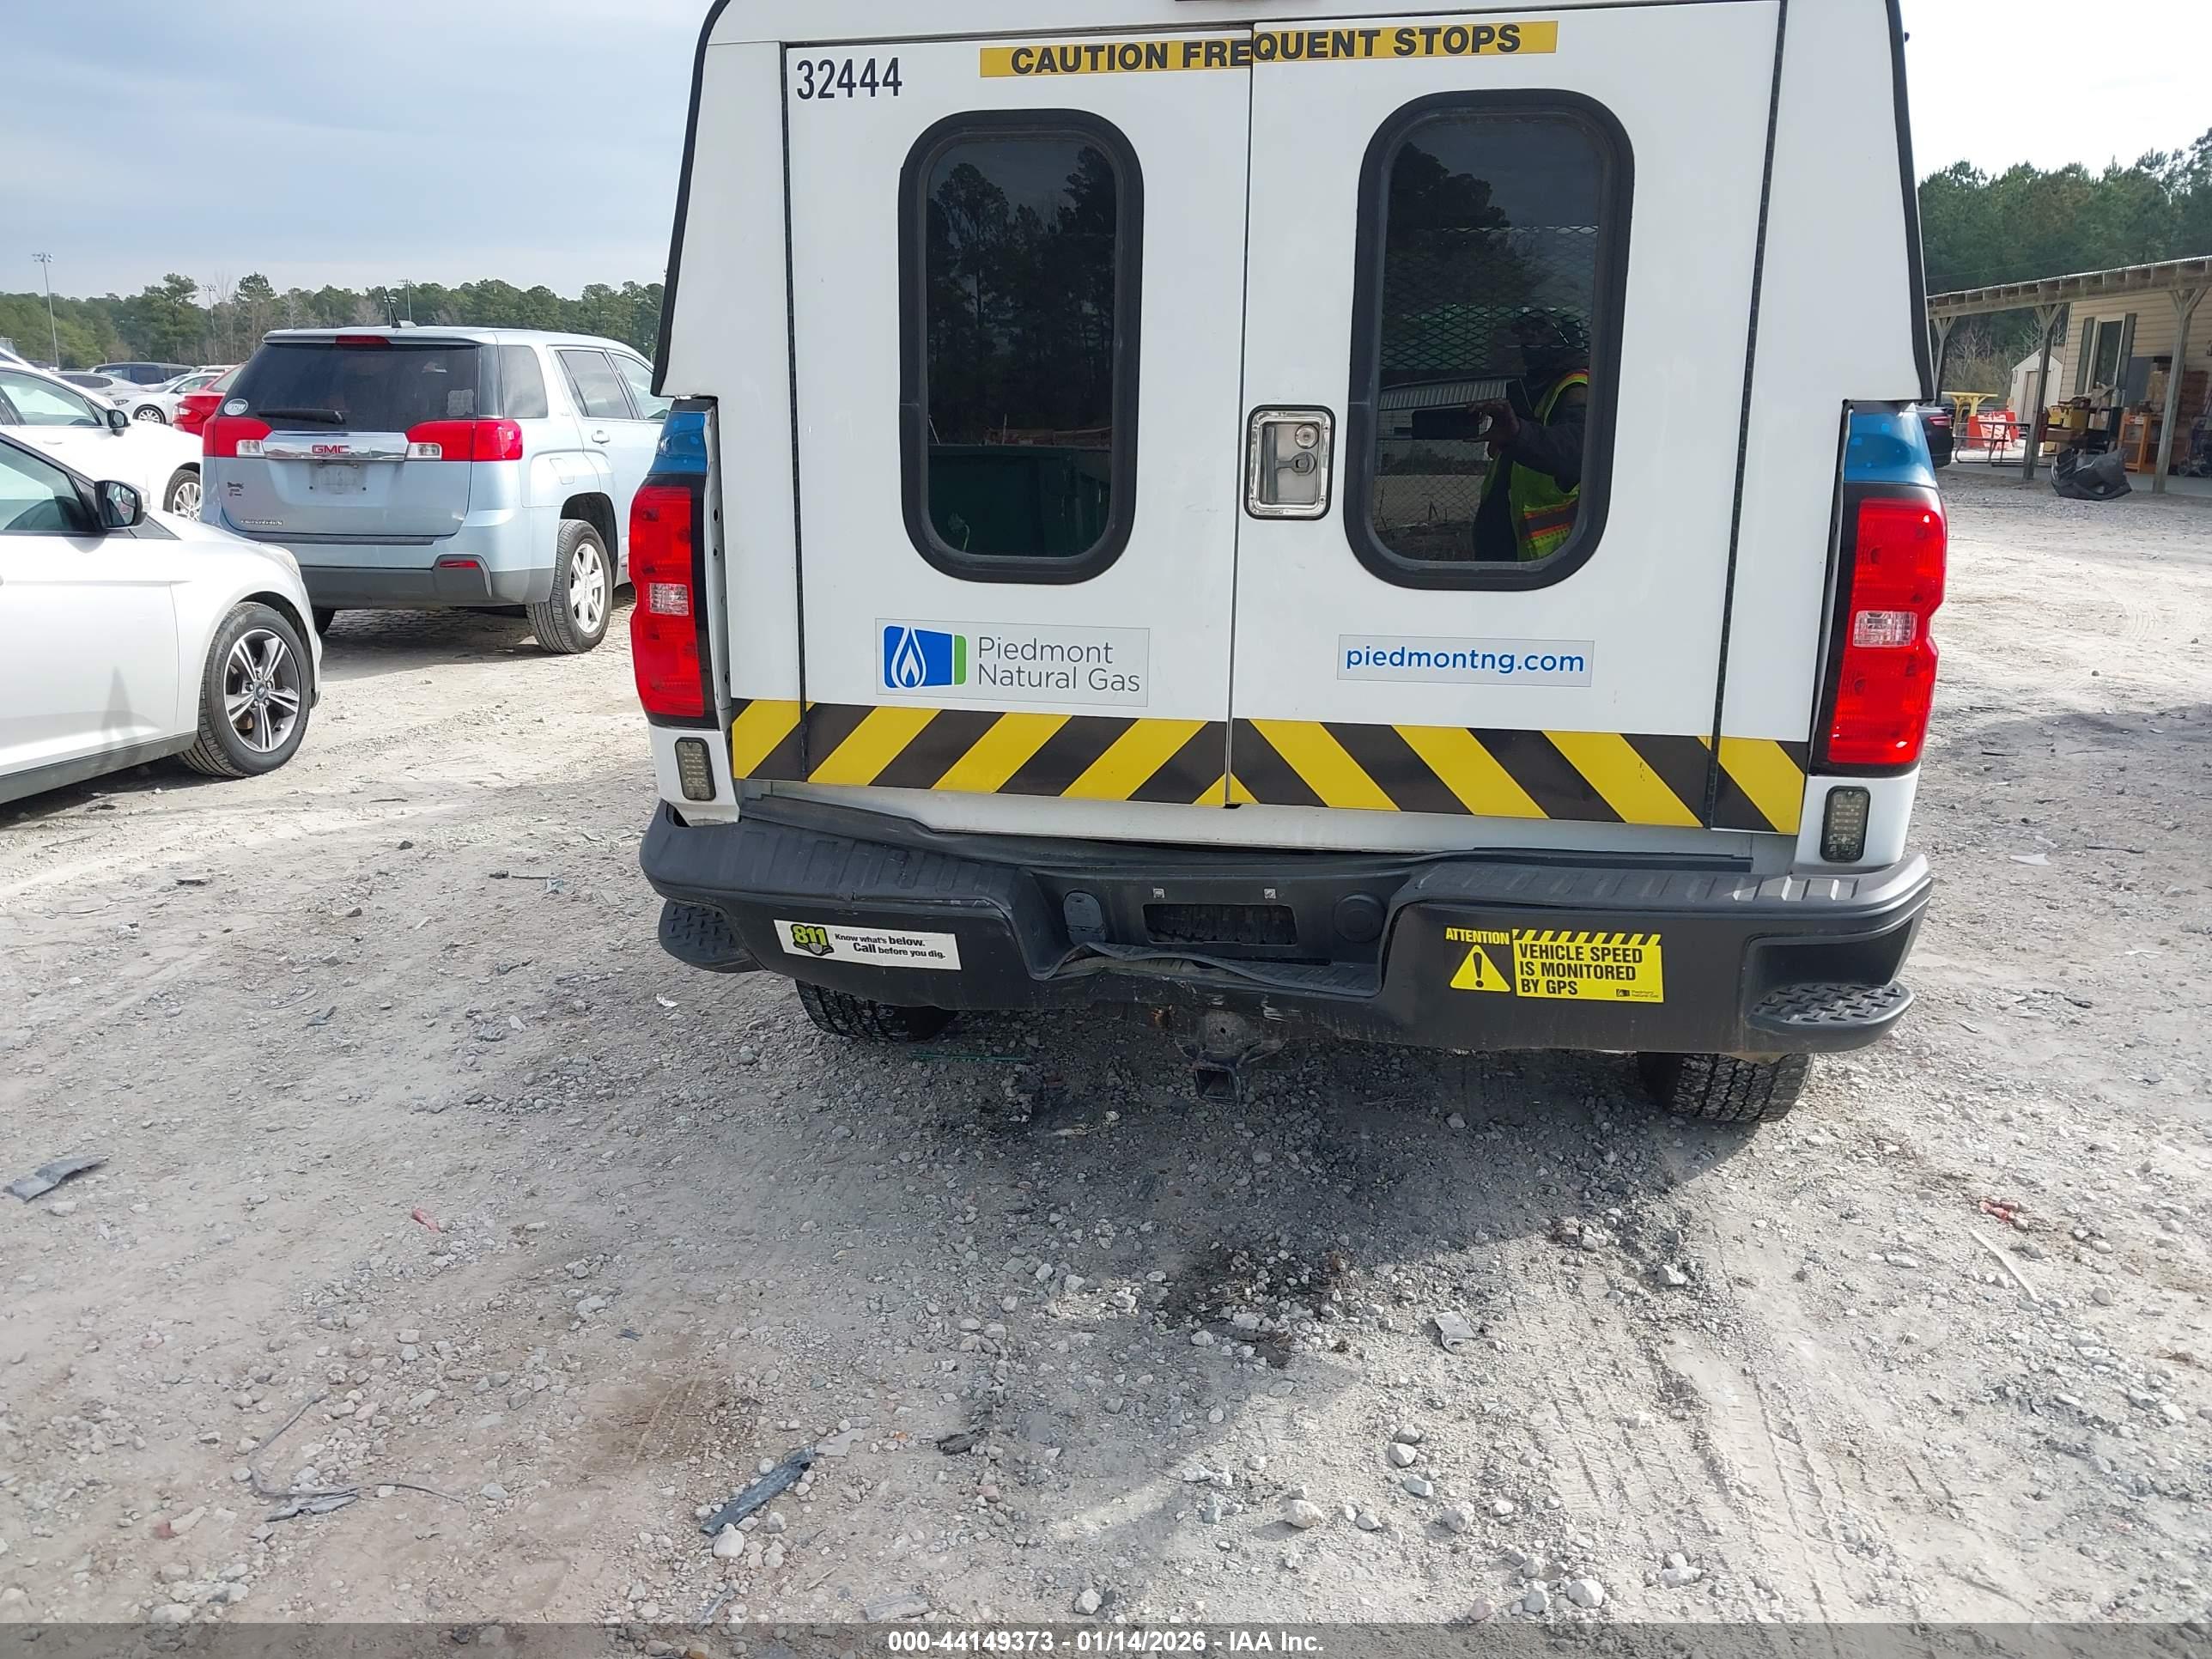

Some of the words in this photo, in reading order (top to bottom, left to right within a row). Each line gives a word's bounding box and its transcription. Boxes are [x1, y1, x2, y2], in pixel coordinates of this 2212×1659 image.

[1012, 43, 1169, 74] CAUTION
[1182, 30, 1381, 68] FREQUENT
[1394, 25, 1521, 56] STOPS
[796, 57, 902, 100] 32444
[312, 445, 350, 454] GMC
[978, 636, 1114, 664] Piedmont
[1346, 646, 1584, 674] piedmontng.com
[978, 664, 1077, 689] Natural
[1088, 667, 1140, 692] Gas
[792, 924, 827, 945] 811
[888, 936, 926, 946] below.
[1445, 927, 1510, 945] ATTENTION
[853, 942, 876, 953] Call
[878, 946, 908, 955] before
[1519, 944, 1584, 961] VEHICLE
[1590, 946, 1643, 963] SPEED
[1520, 961, 1535, 976] IS
[1540, 962, 1636, 981] MONITORED
[1521, 978, 1540, 994] BY
[1546, 980, 1578, 995] GPS
